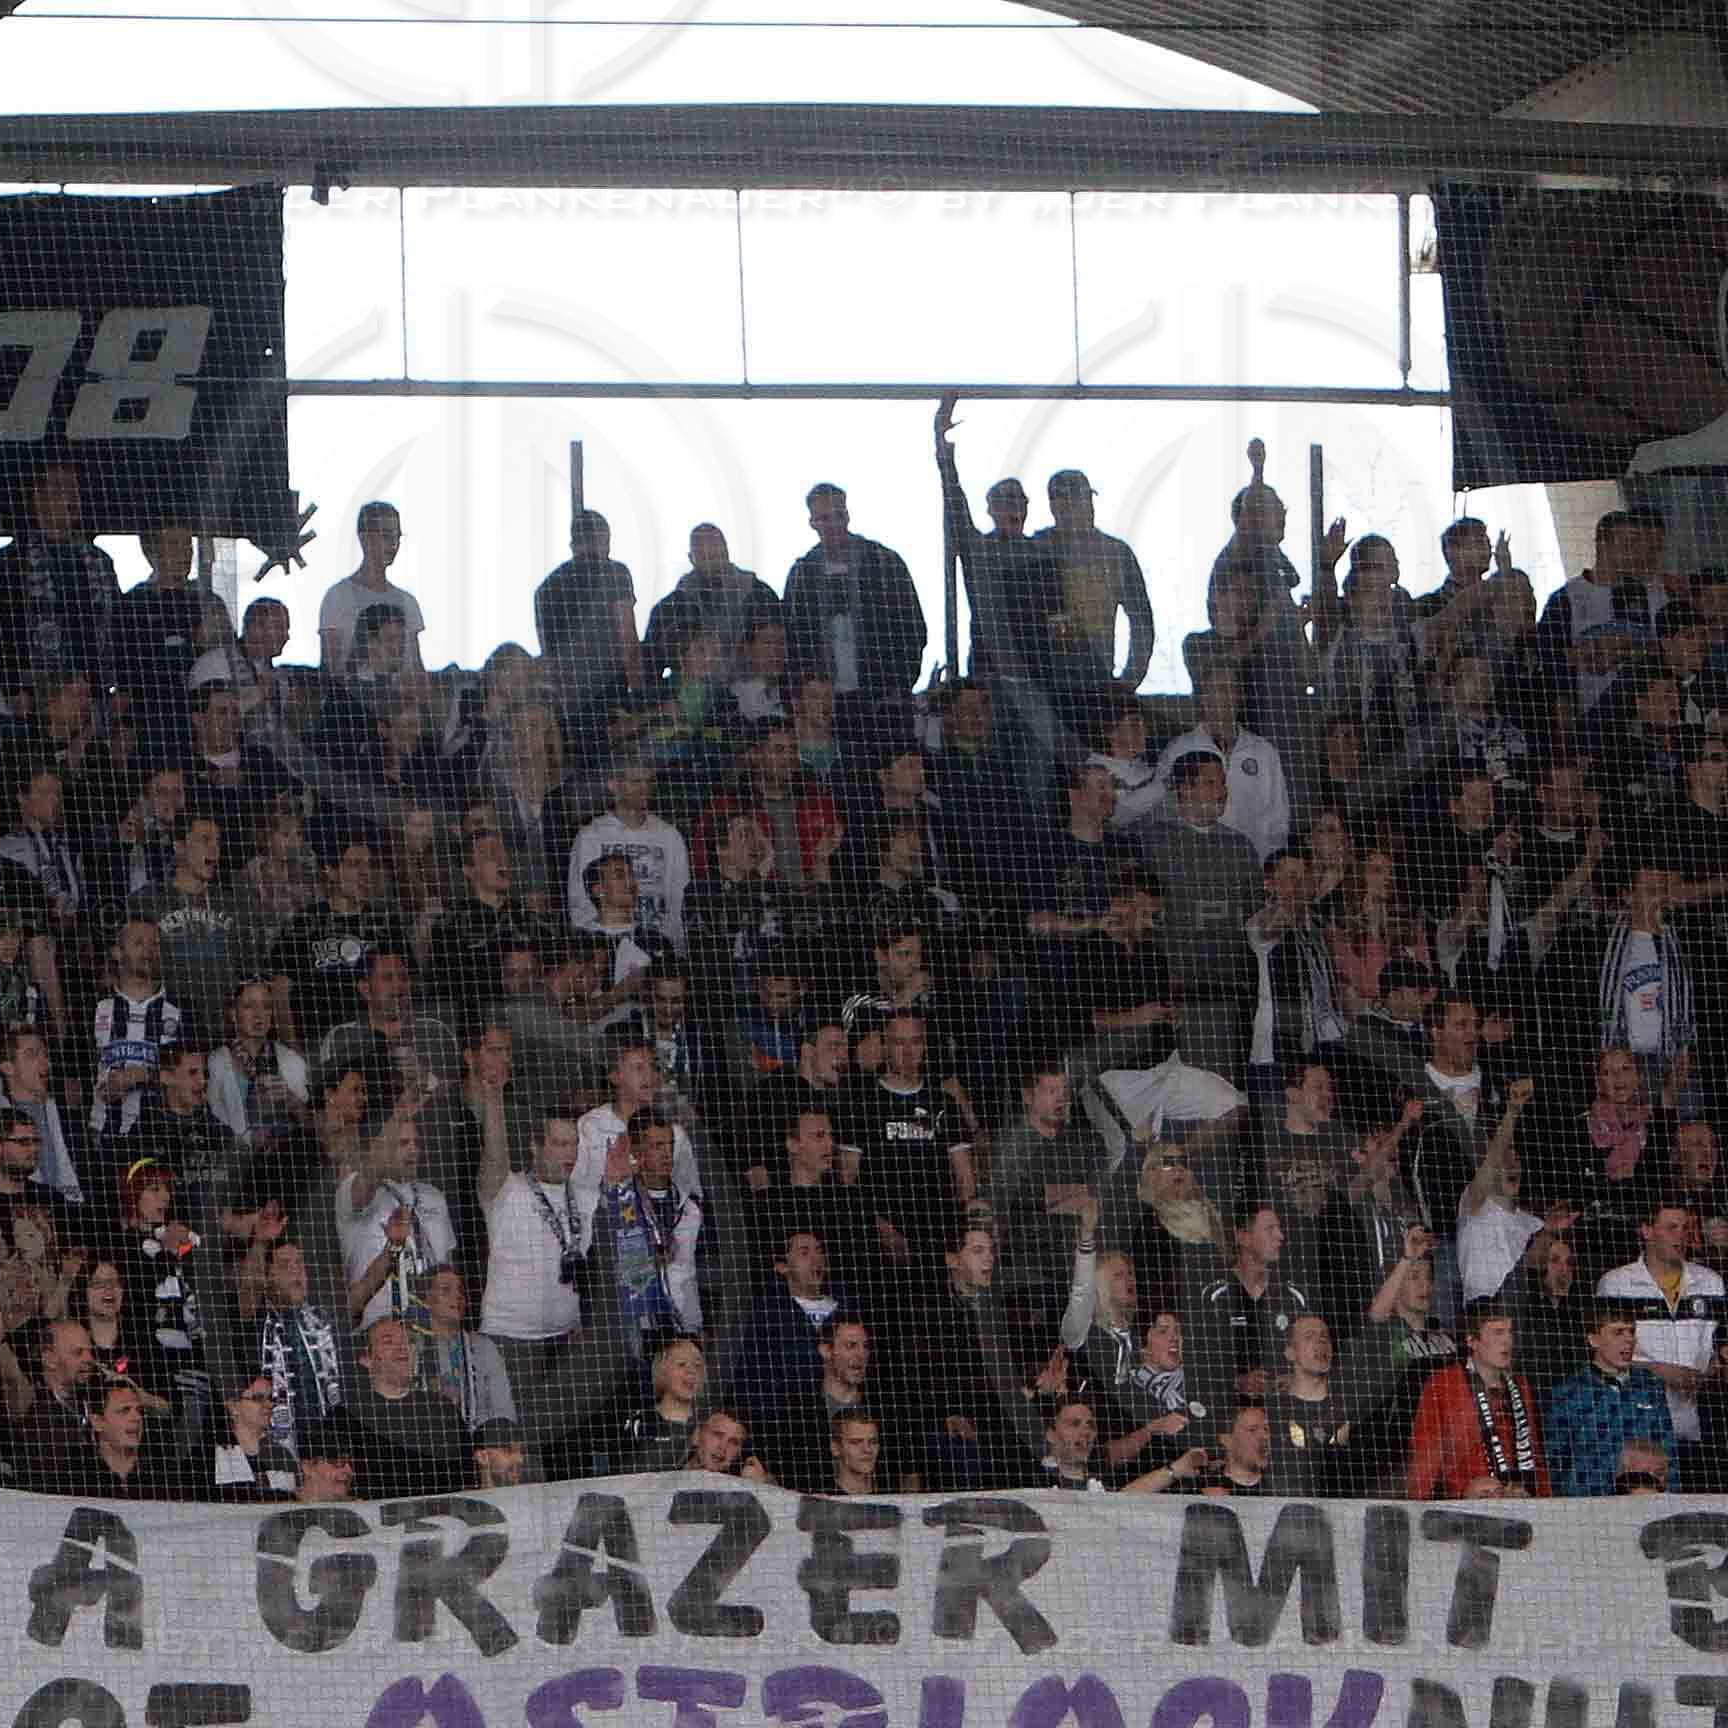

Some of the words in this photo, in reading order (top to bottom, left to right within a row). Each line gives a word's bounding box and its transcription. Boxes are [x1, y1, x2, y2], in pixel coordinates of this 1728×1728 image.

[27, 1507, 144, 1650] A
[255, 1490, 1057, 1658] GRAZER
[1167, 1502, 1533, 1650] MIT
